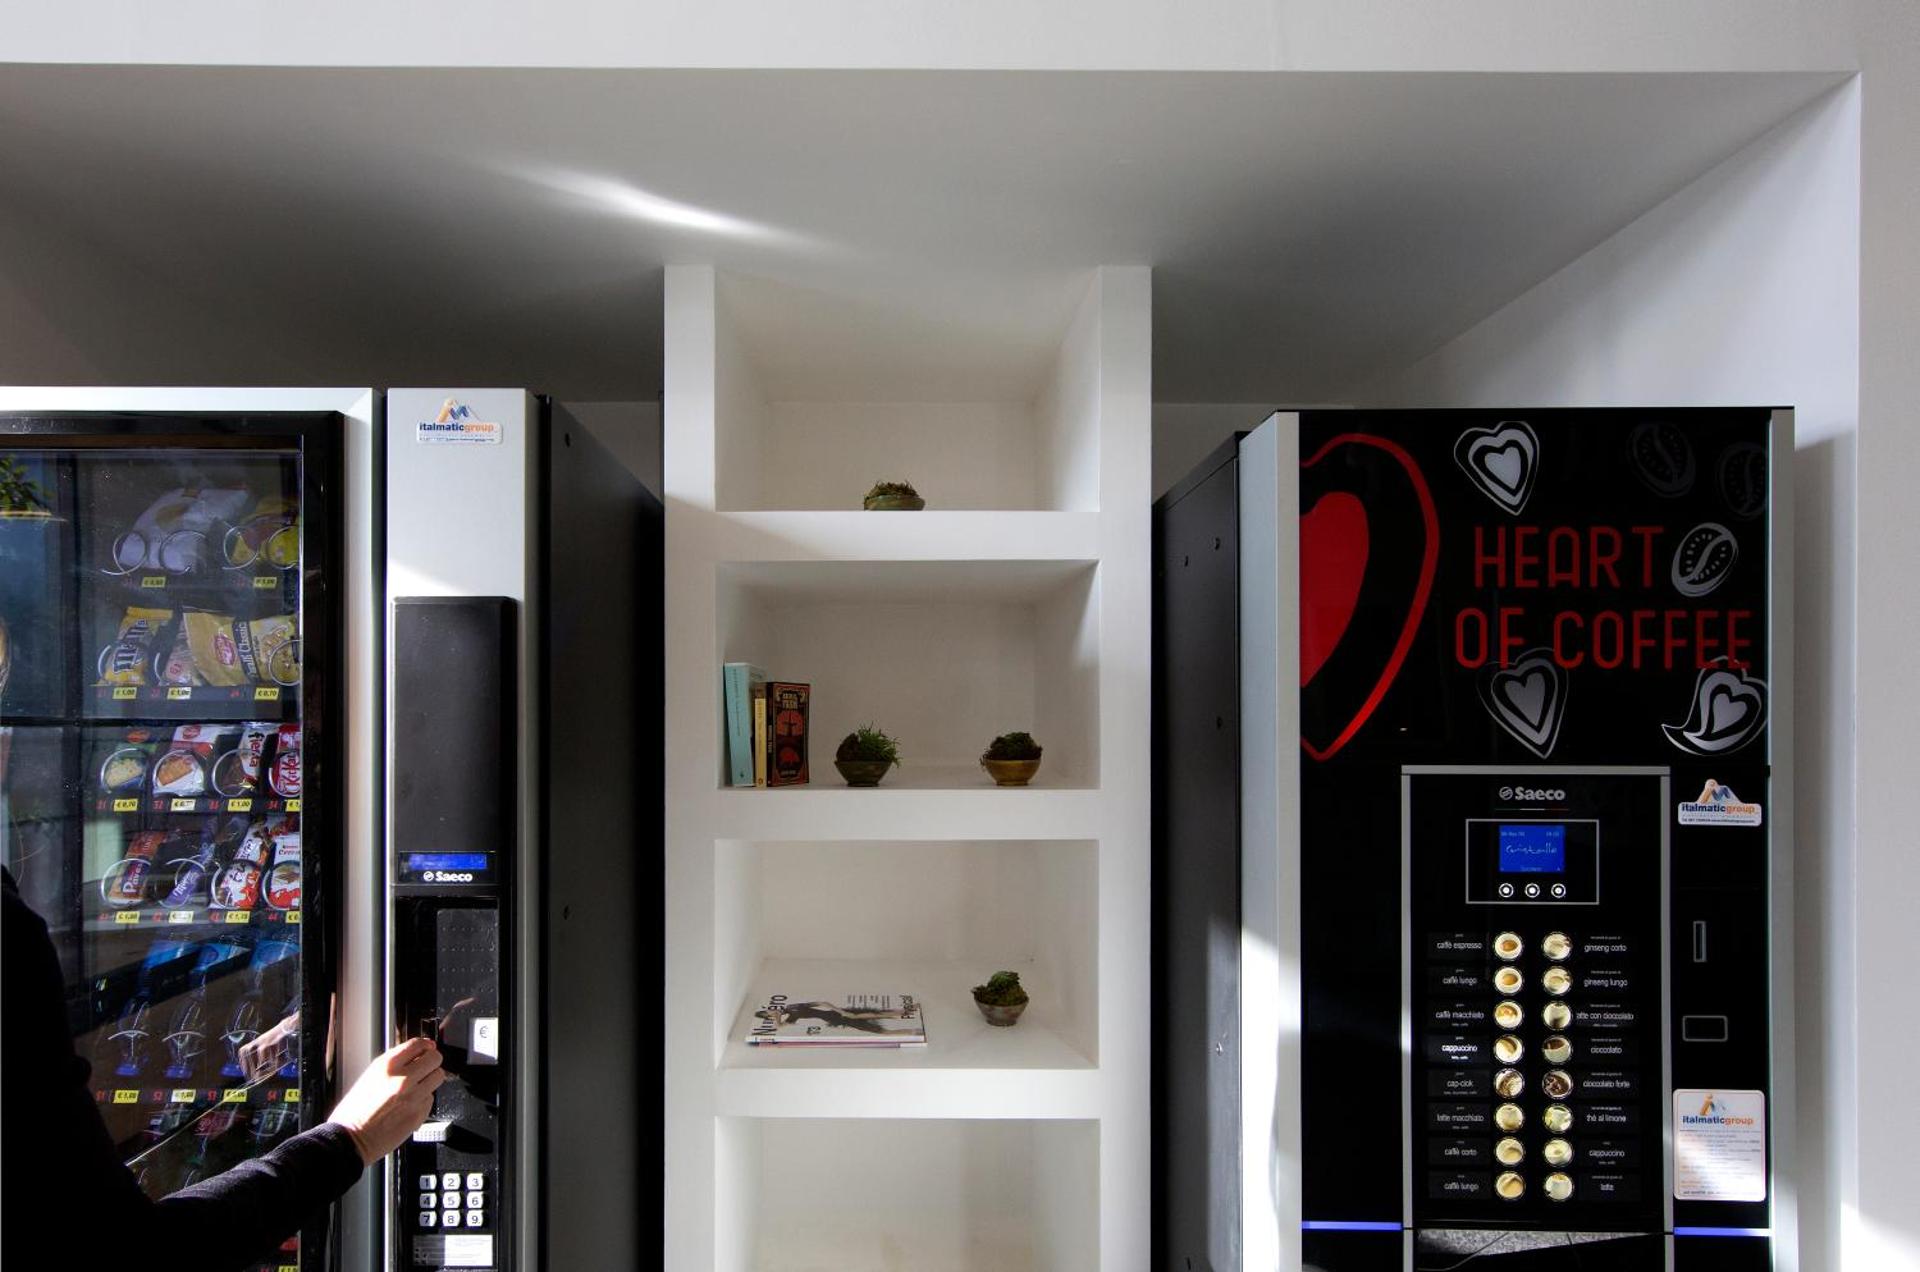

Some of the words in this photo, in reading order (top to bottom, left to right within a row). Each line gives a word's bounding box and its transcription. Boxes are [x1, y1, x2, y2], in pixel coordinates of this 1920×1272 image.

[419, 422, 494, 433] italmaticgroup
[1474, 525, 1664, 588] HEART
[1455, 607, 1525, 669] OF
[1553, 609, 1752, 671] COFFEE
[1514, 786, 1565, 800] Saeco
[1682, 803, 1755, 814] italmaticgroup
[435, 871, 473, 882] Saeco
[1453, 942, 1483, 950] espresso
[1584, 944, 1609, 953] ginseng
[1584, 978, 1609, 987] ginseng
[1610, 978, 1628, 987] lungo
[1441, 1043, 1478, 1053] cappuccino
[1590, 1045, 1622, 1054] cioccolato
[1583, 1079, 1614, 1088] cioccolato
[1452, 1113, 1484, 1122] macchiato
[1682, 1115, 1754, 1126] italmaticgroup
[1589, 1149, 1625, 1158] cappuccino
[447, 1178, 455, 1187] 2
[472, 1178, 479, 1187] 3
[423, 1197, 431, 1206] 4
[447, 1196, 455, 1206] 5
[472, 1196, 479, 1206] 6
[423, 1215, 431, 1224] 7
[447, 1215, 455, 1224] 8
